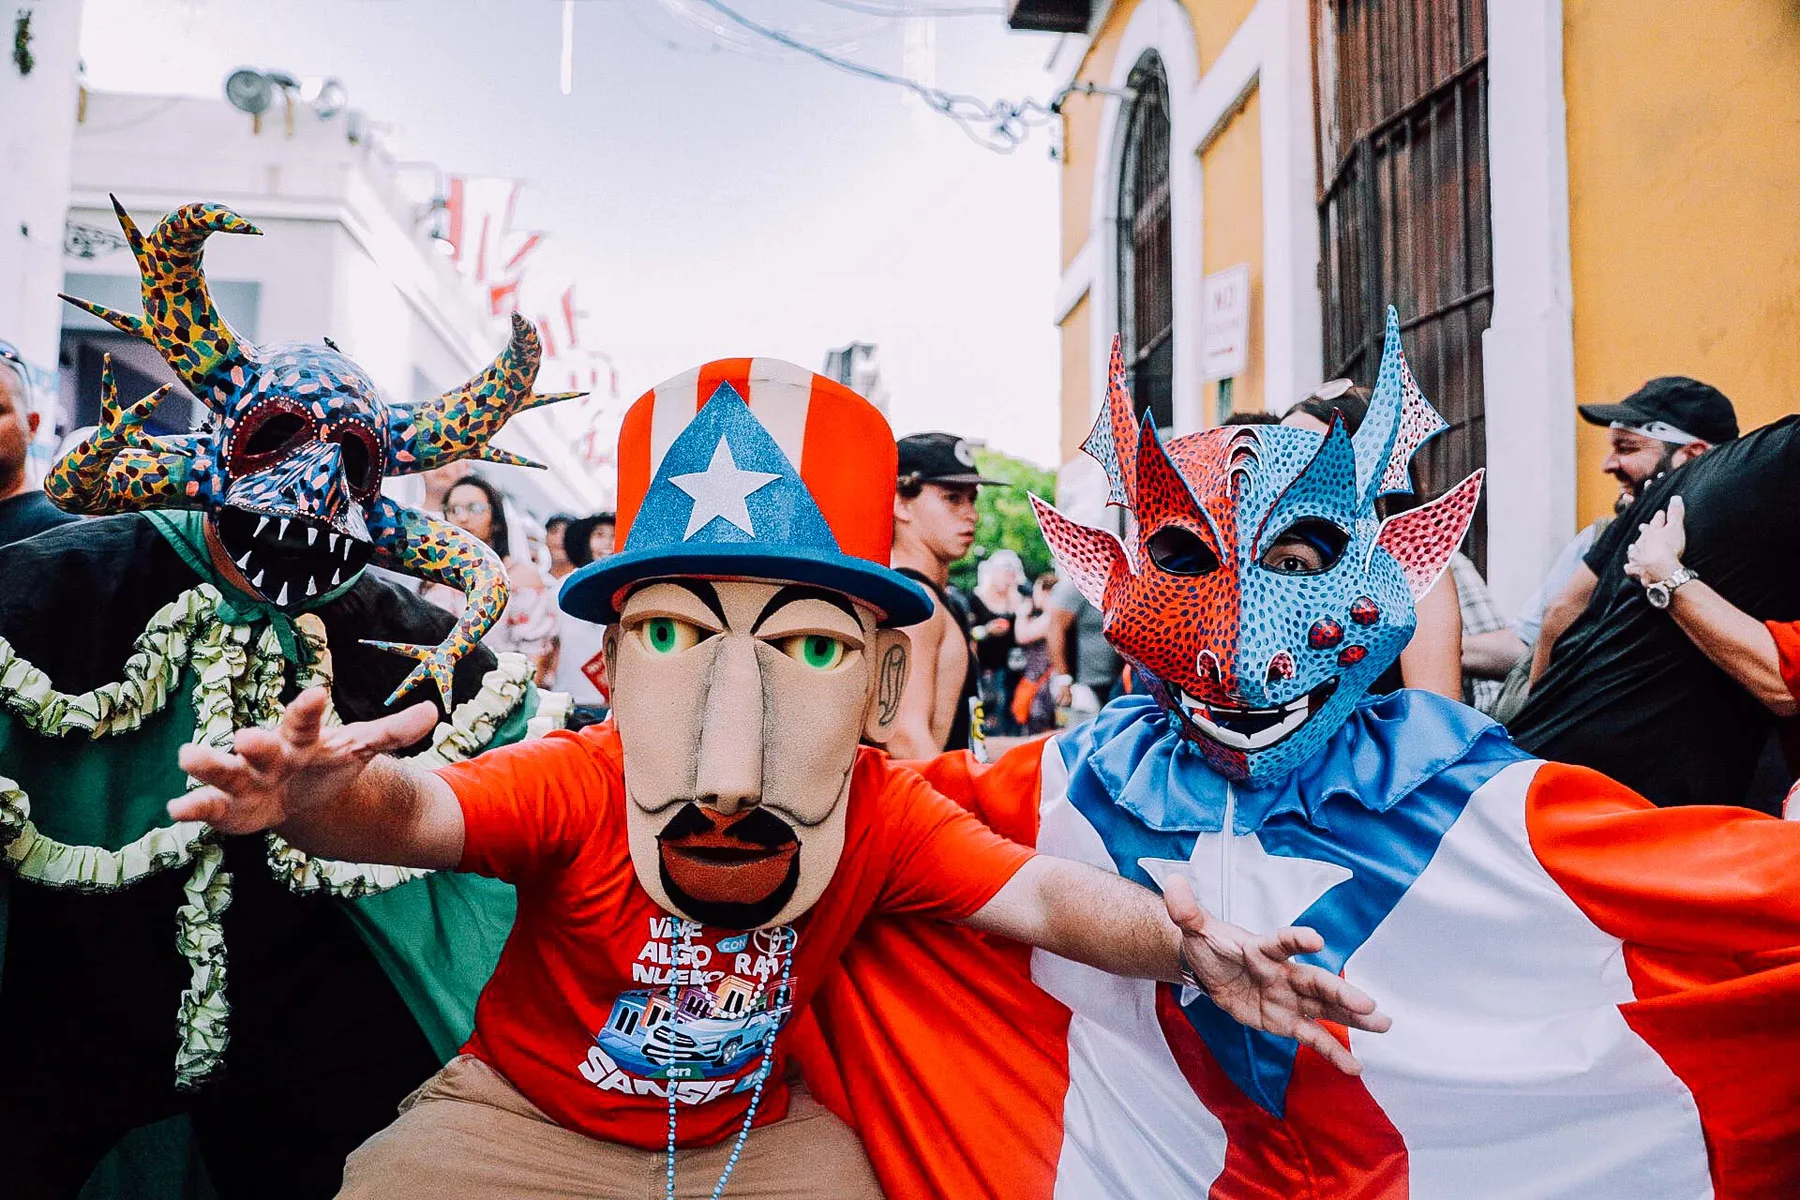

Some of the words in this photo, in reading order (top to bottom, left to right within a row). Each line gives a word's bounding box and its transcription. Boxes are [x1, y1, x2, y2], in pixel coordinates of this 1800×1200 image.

[637, 941, 712, 967] ALGO
[722, 939, 747, 951] CON
[632, 963, 725, 985] NUEVO
